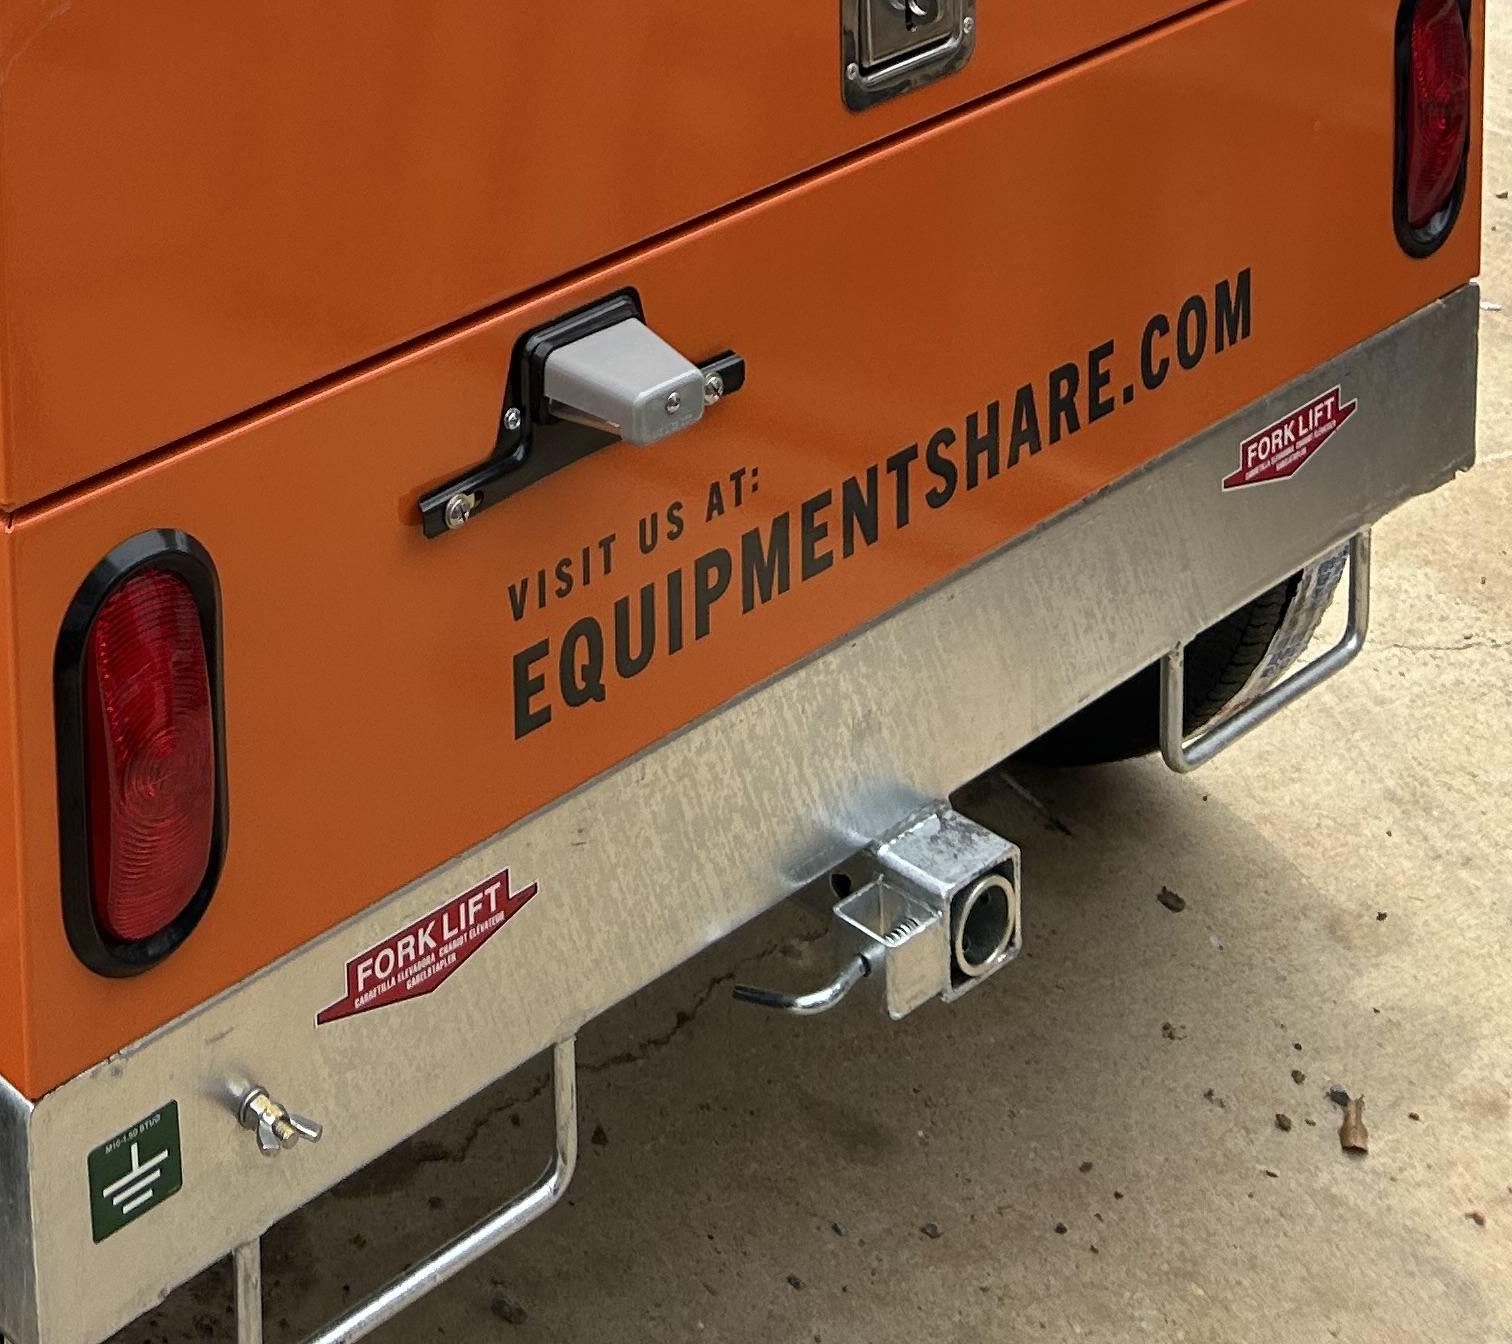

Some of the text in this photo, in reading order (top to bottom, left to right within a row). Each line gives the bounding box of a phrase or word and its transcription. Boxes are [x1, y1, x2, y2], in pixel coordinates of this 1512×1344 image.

[1248, 420, 1295, 468] FORK
[1298, 397, 1335, 437] LIFT
[508, 467, 759, 621] VISIT US AT:
[512, 267, 1252, 739] EQUIPMENTSHARE.COM
[357, 881, 501, 992] FORK LIFT
